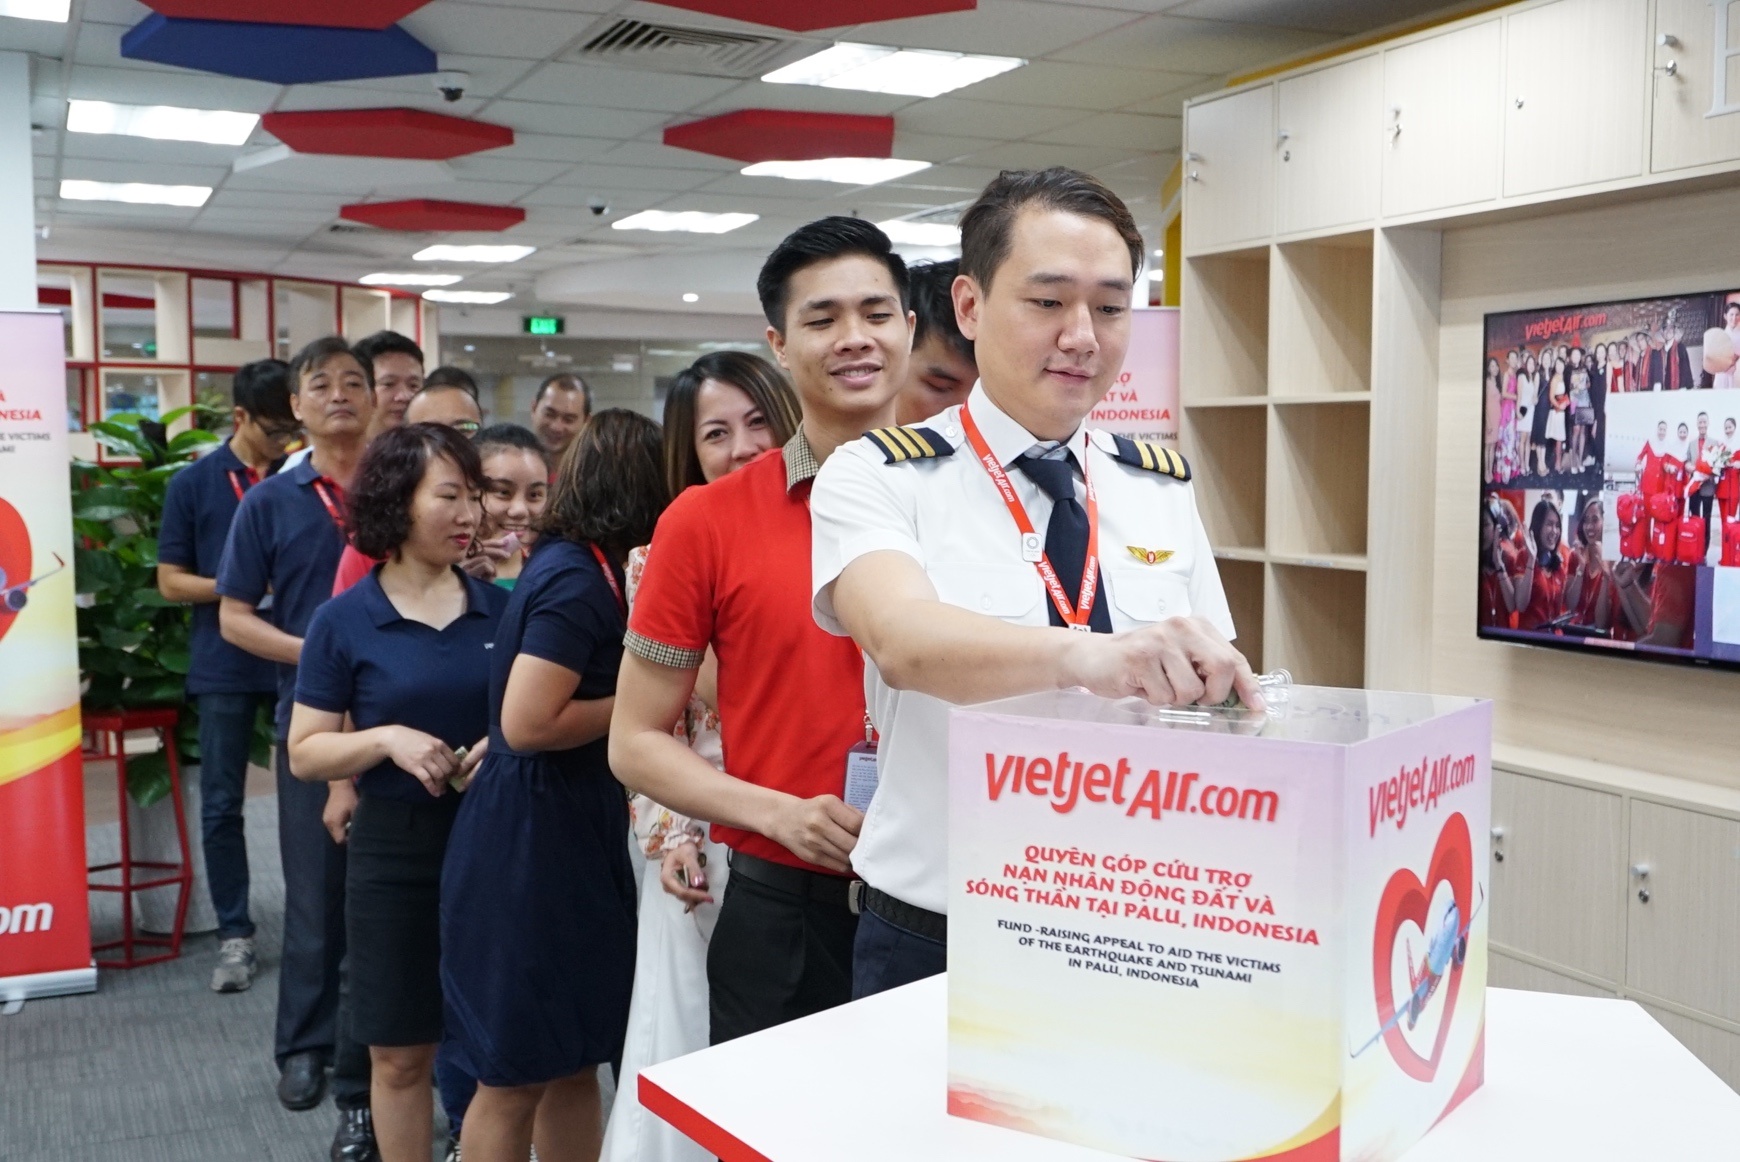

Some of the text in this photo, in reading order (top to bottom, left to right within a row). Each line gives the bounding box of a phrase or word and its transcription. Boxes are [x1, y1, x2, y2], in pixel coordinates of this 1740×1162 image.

[1091, 408, 1170, 420] INDONESIA
[1139, 432, 1178, 440] VICTIMS
[1003, 864, 1276, 916] NẠN NHÂN ĐỘNG ĐẤT VÀ
[1102, 854, 1147, 873] GÓP
[1153, 859, 1199, 882] CỨU
[1205, 869, 1252, 893] TRỢ
[966, 878, 1019, 903] SÓNG
[1086, 897, 1118, 918] TẠI
[1193, 913, 1320, 946] INDONESIA
[997, 919, 1032, 933] FUND
[1093, 935, 1144, 951] APPEAL
[1148, 943, 1165, 954] TO
[1168, 947, 1192, 960] AID
[1196, 950, 1222, 964] THE
[1226, 955, 1281, 973] VICTIMS
[1019, 937, 1252, 983] OF THE EARTHQUAKE AND TSUNAMI
[1068, 958, 1082, 968] IN
[1126, 967, 1199, 988] INDONESIA
